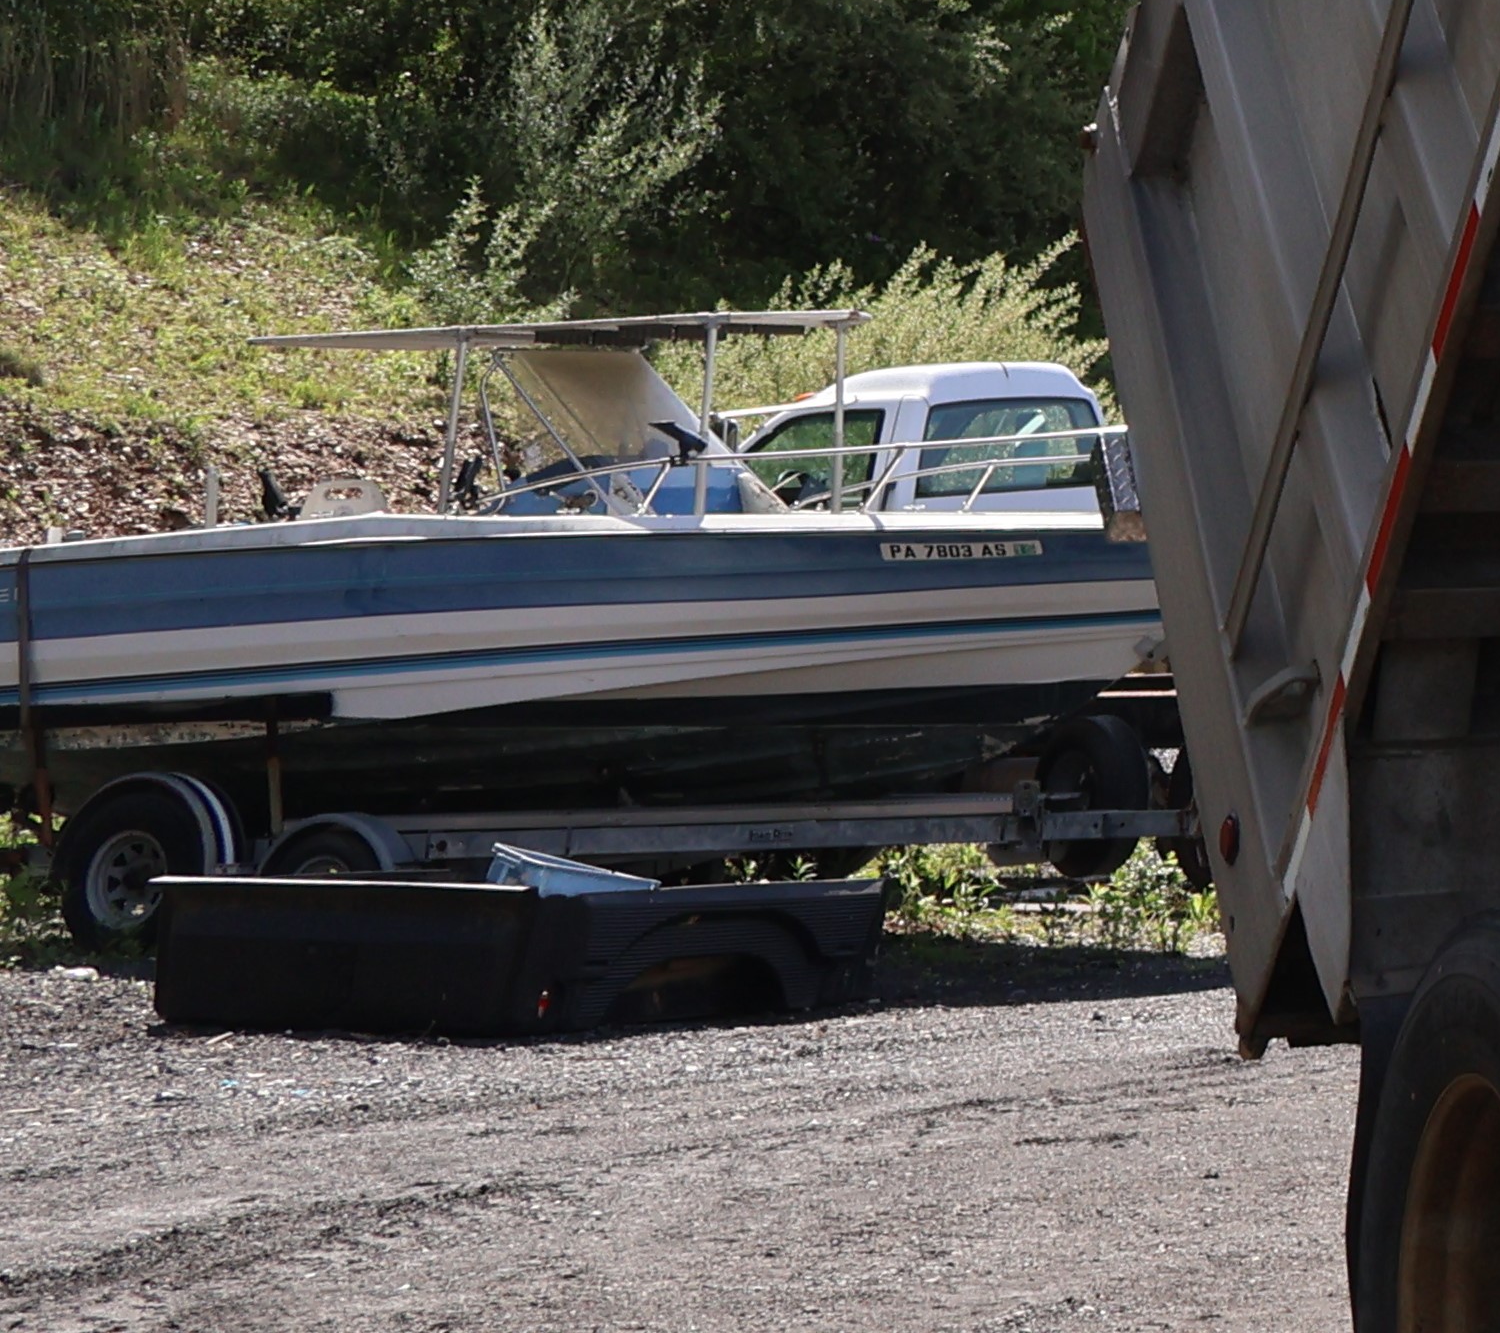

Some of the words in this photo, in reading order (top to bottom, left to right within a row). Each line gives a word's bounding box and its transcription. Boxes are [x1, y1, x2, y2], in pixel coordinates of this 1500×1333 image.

[889, 544, 917, 559] PA
[924, 543, 973, 559] 7803
[981, 543, 1007, 557] AS
